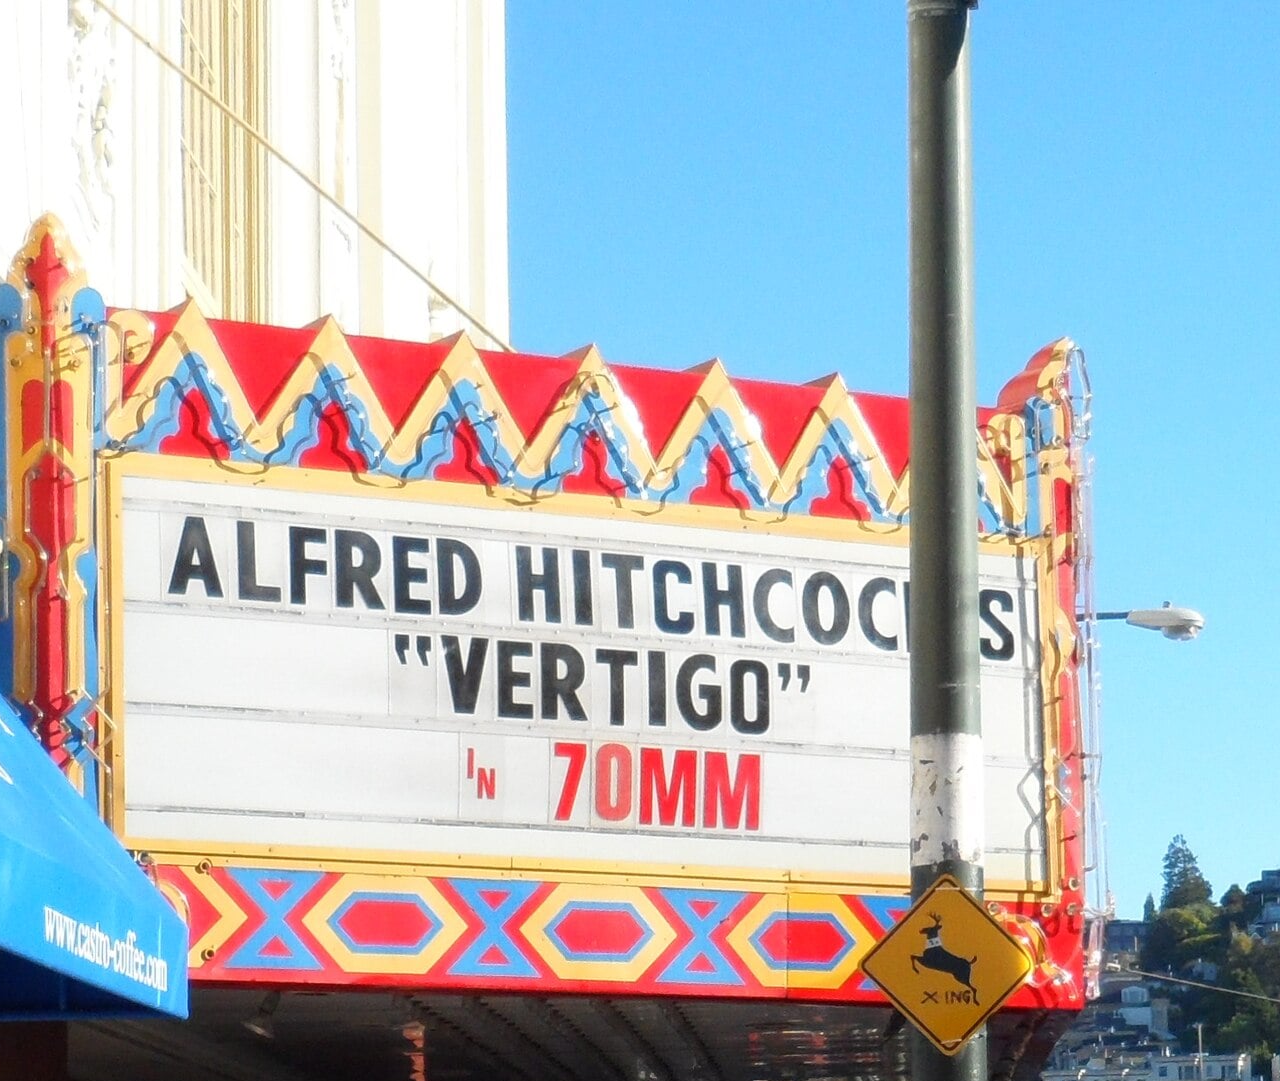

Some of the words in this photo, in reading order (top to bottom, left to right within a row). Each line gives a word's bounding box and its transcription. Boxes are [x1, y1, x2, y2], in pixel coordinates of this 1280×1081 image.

[168, 516, 483, 616] ALFRED
[515, 545, 1015, 662] HITCHCOCS
[394, 633, 811, 735] "VERTIGO"
[554, 742, 761, 831] 70MM
[44, 905, 168, 992] www.castro-coffee.com
